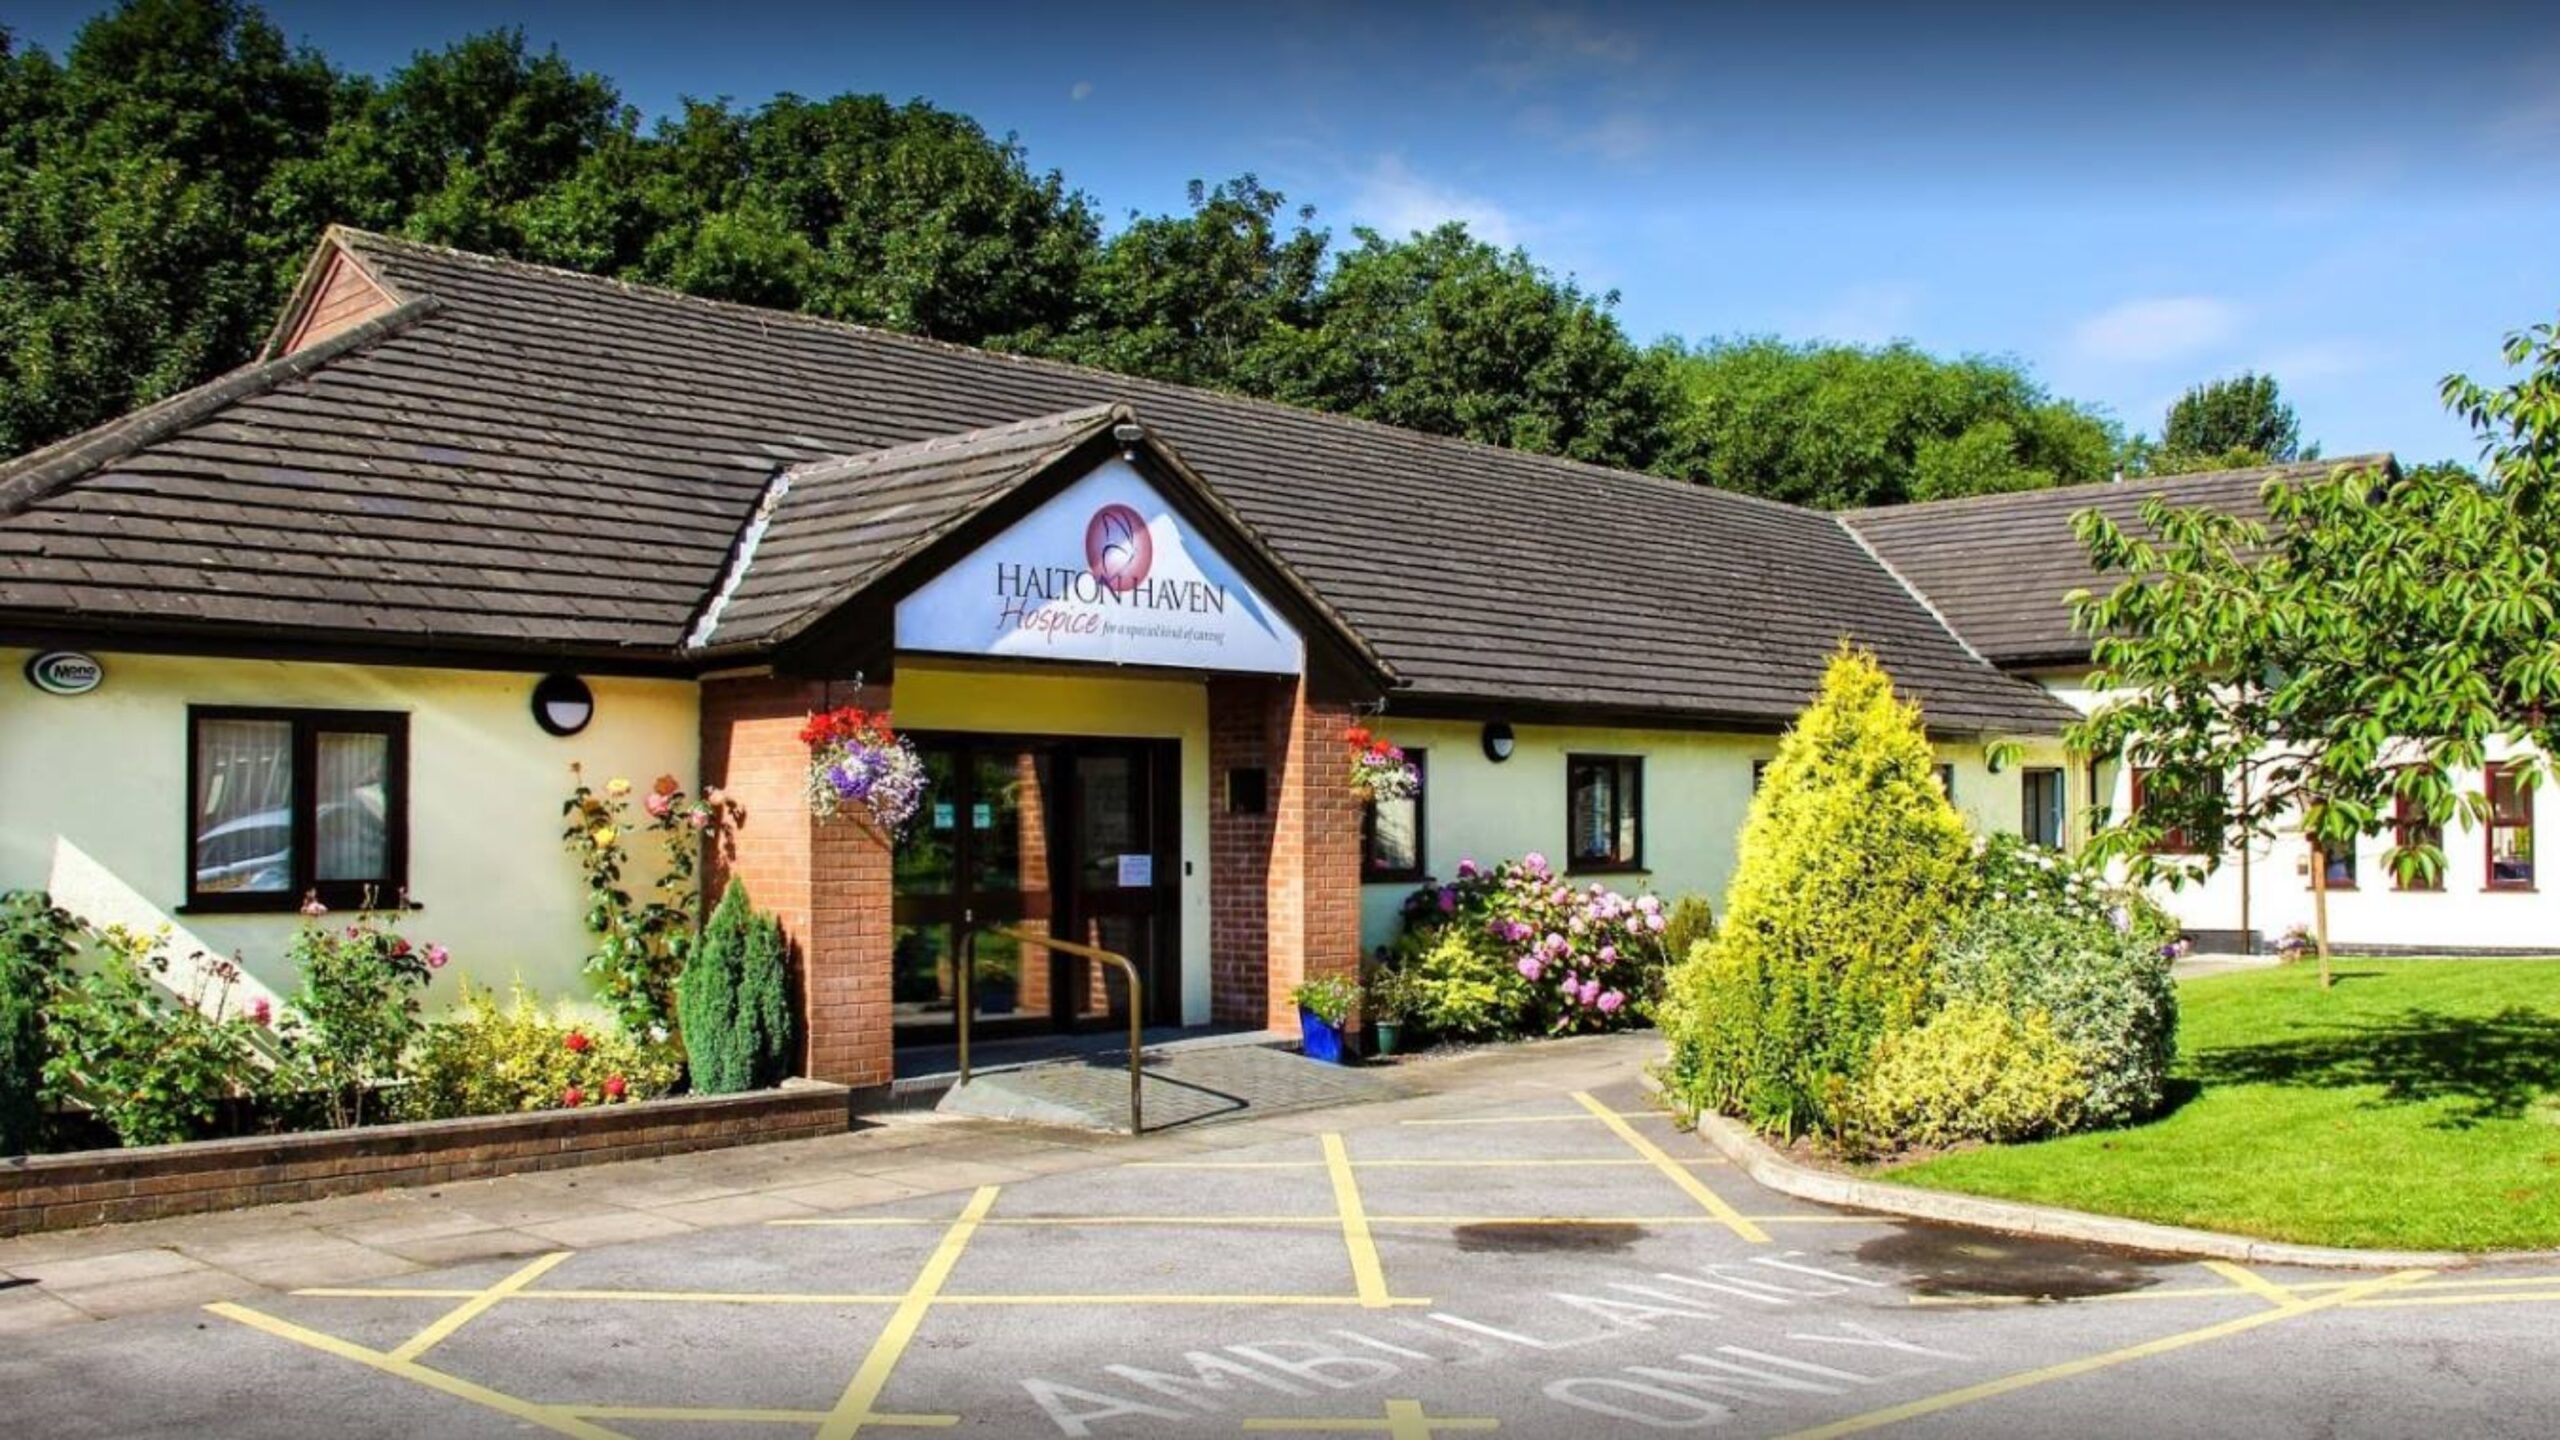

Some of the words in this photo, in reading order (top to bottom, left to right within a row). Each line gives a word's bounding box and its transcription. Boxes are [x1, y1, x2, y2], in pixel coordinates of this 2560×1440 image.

[997, 562, 1122, 606] HALTON
[1132, 575, 1225, 614] HAVEN
[996, 596, 1100, 644] Hospice
[1541, 1321, 1977, 1428] ONLY
